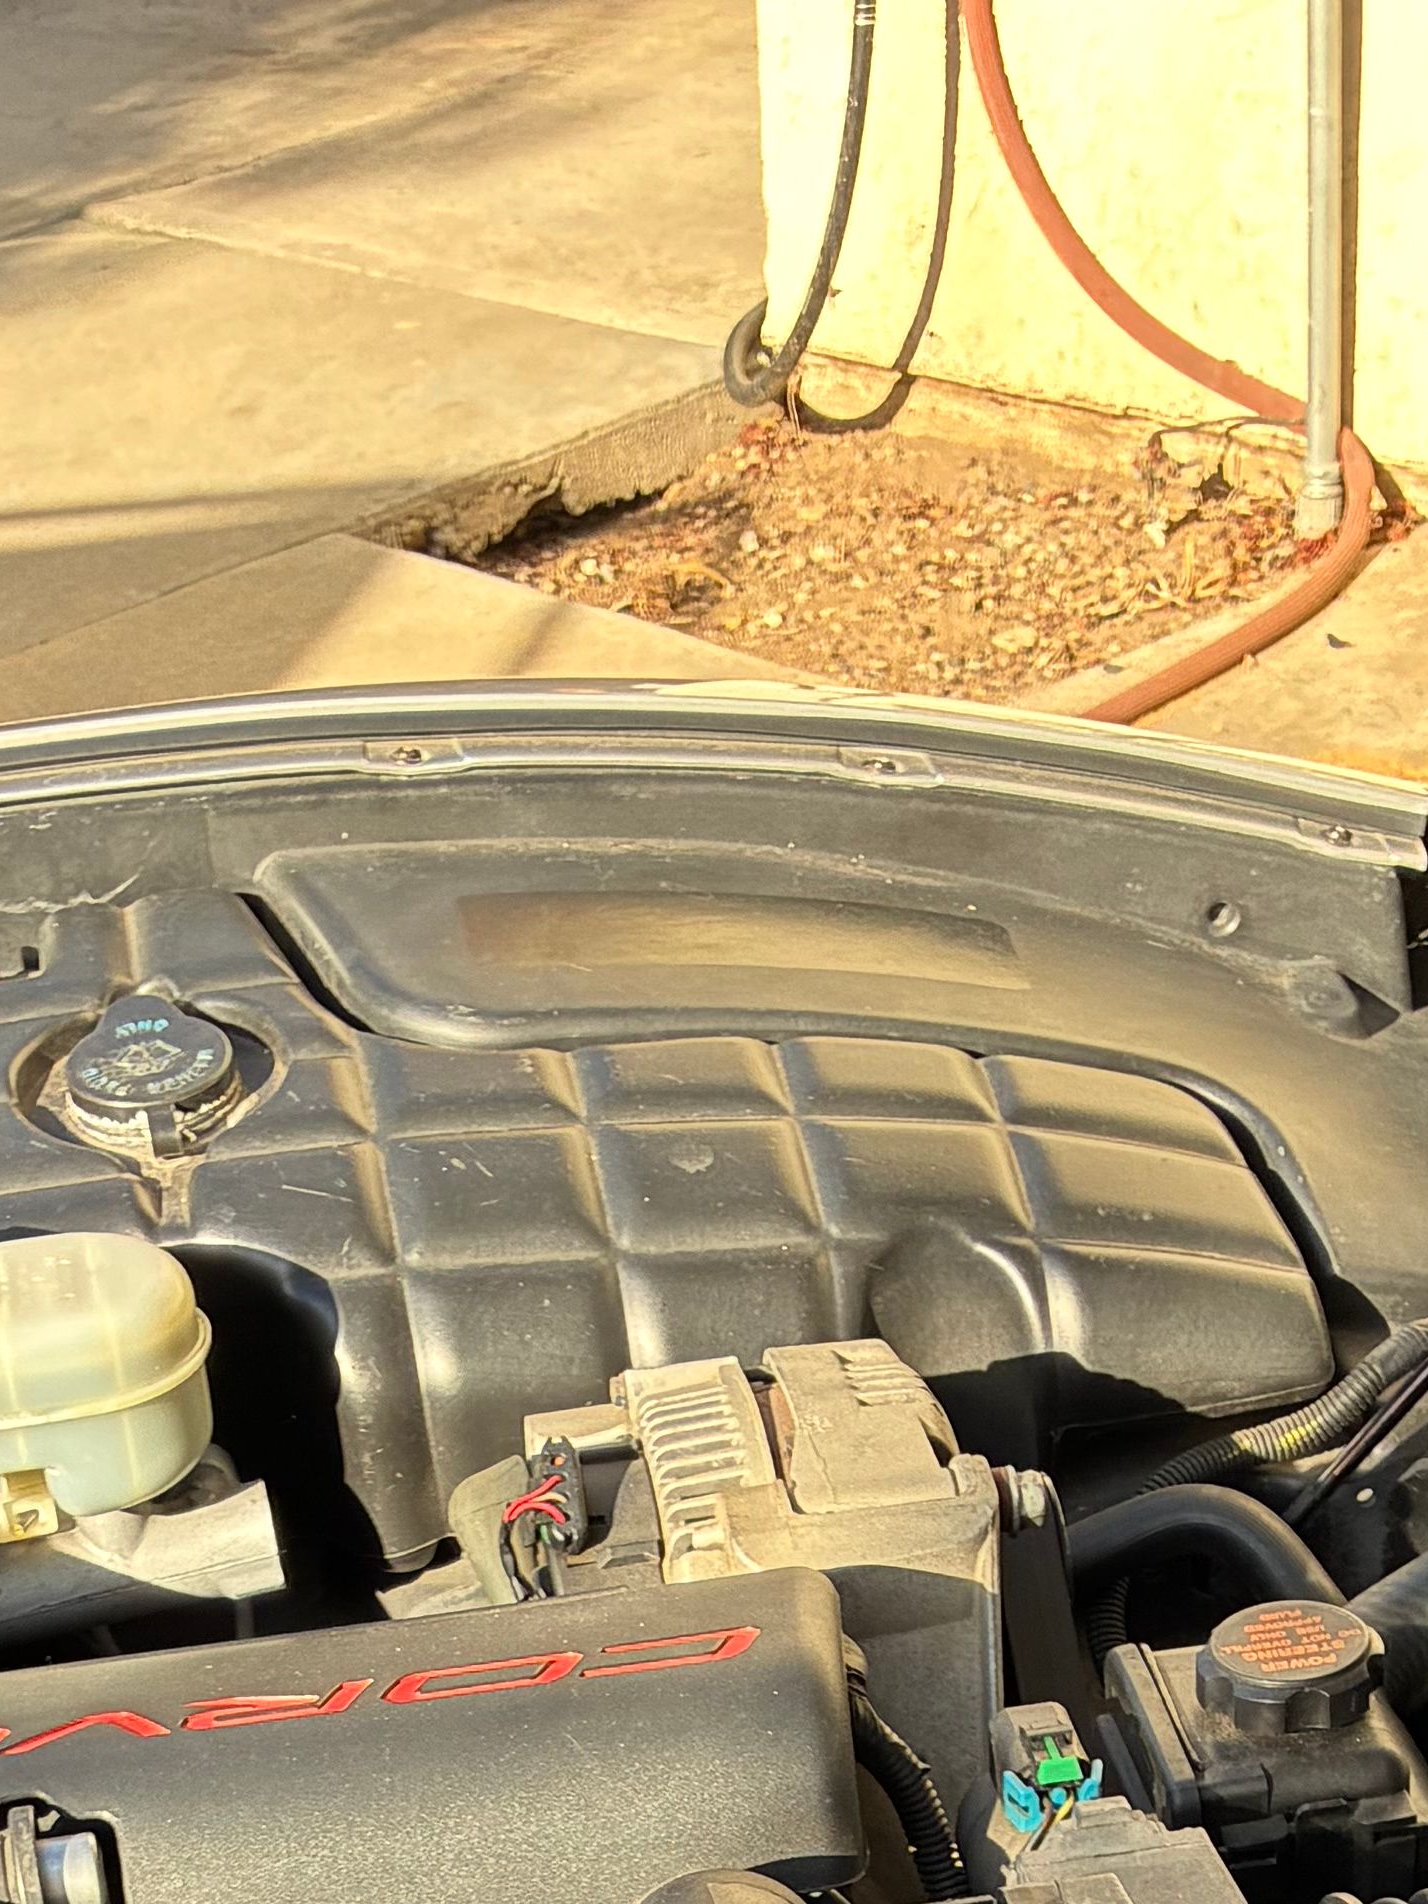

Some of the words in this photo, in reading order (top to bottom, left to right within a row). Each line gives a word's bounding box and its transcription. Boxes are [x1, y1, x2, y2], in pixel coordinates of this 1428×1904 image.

[1243, 1615, 1322, 1633] APPROVED
[1301, 1632, 1331, 1643] NOT
[1241, 1639, 1345, 1661] STEERING
[1260, 1652, 1337, 1672] POWER
